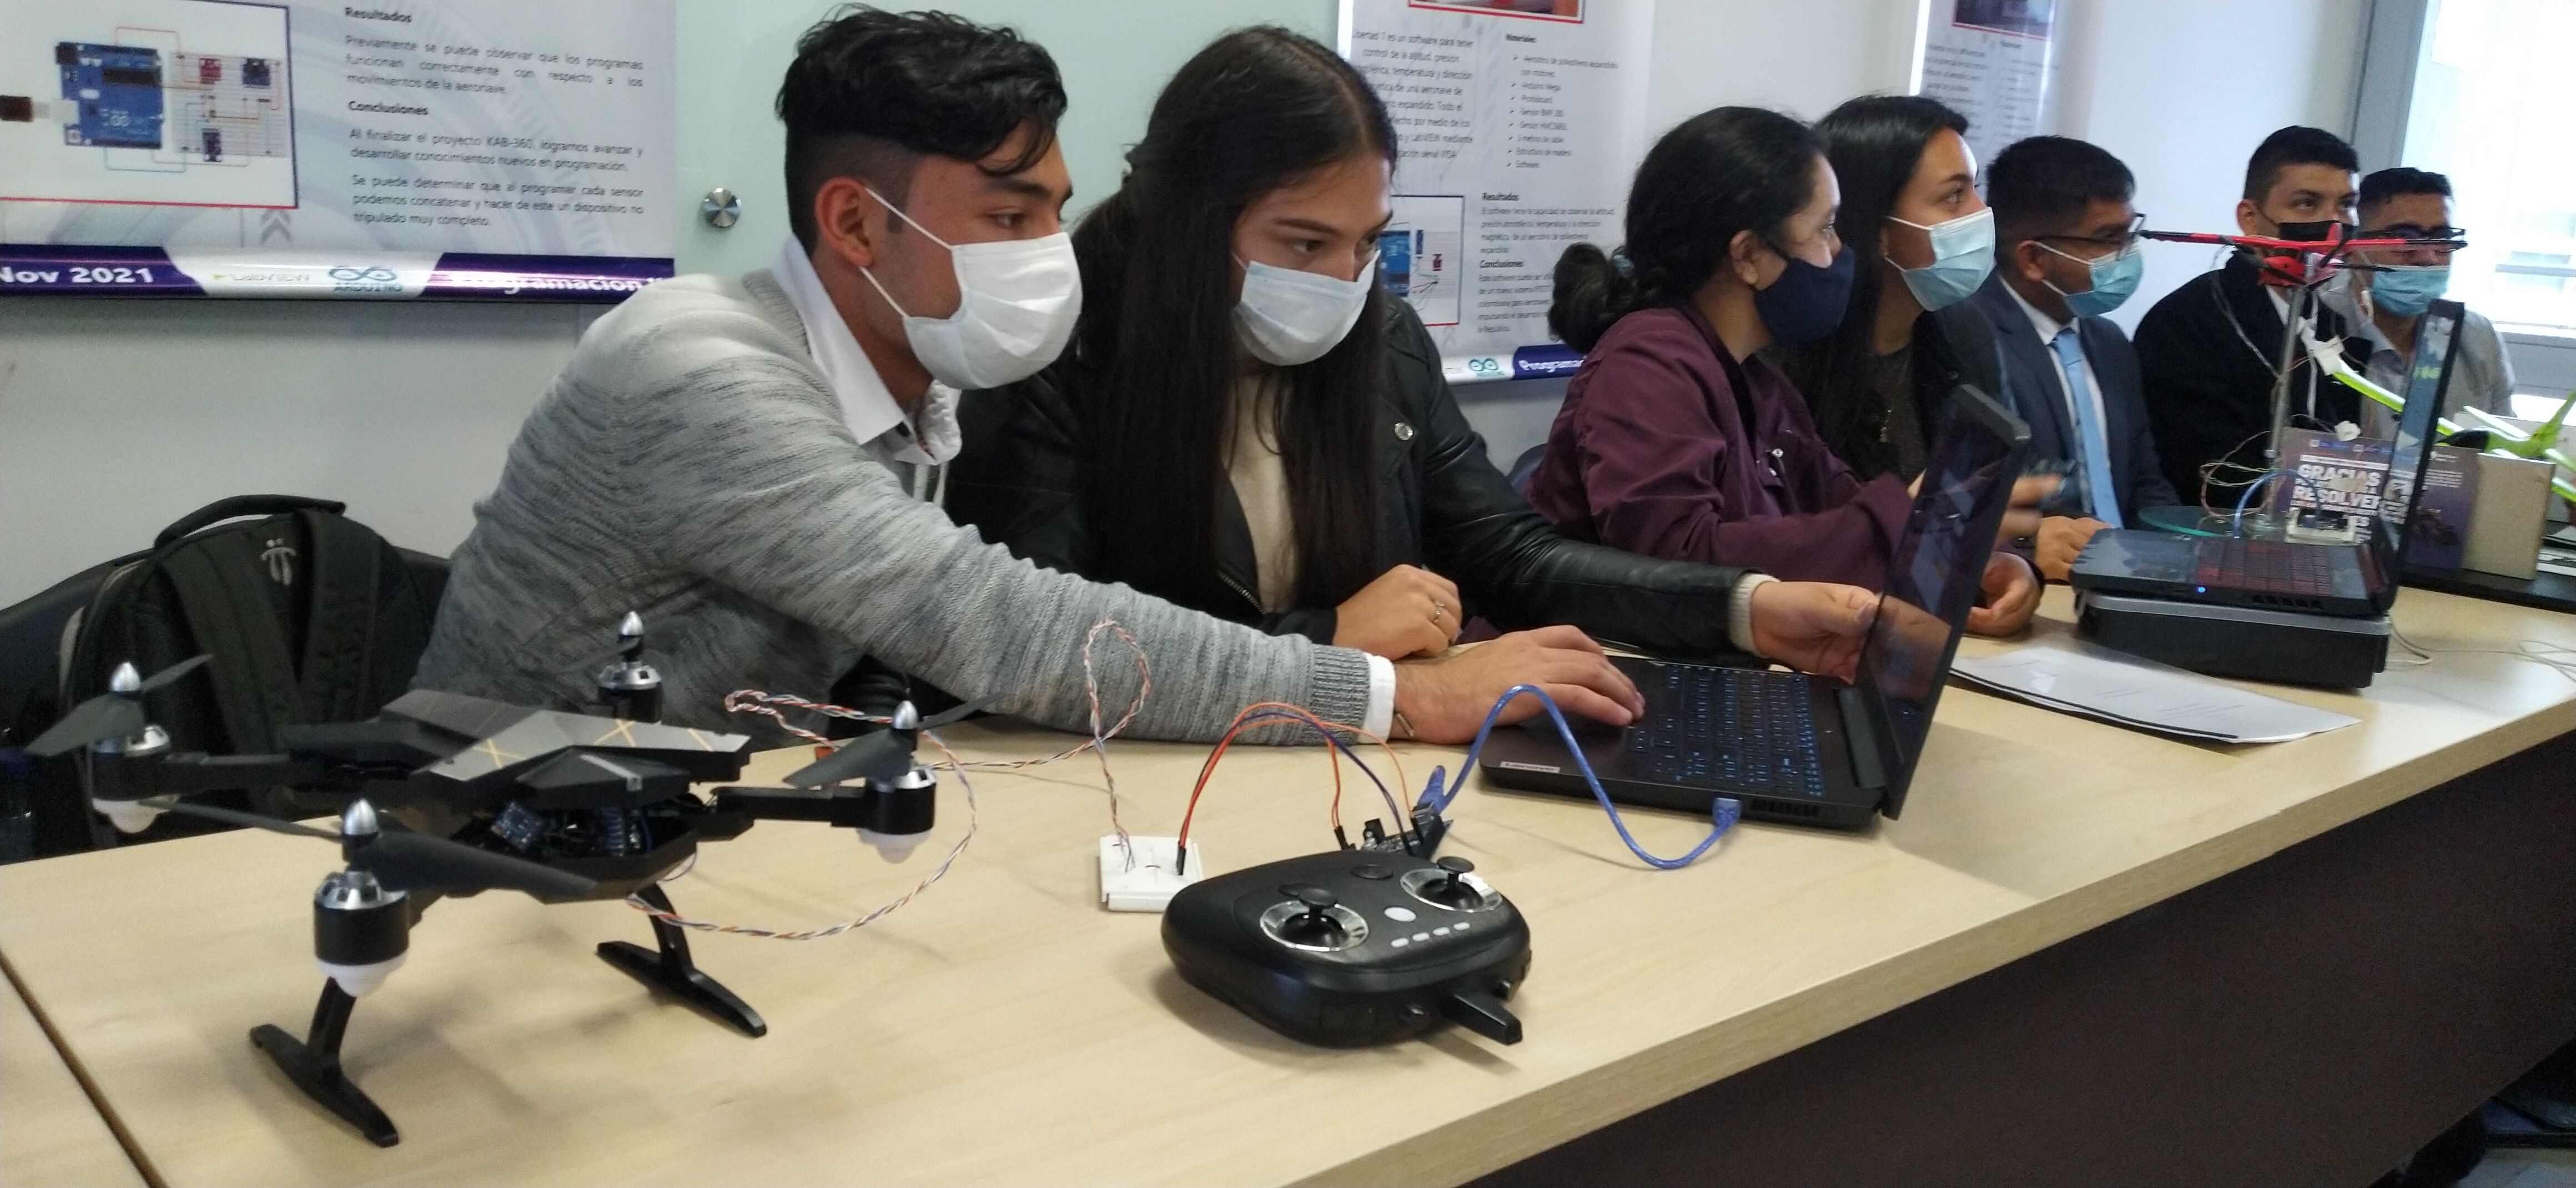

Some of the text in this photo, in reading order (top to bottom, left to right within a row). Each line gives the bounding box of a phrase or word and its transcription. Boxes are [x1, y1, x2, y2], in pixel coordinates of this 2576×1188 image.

[344, 7, 412, 23] Resultados
[345, 35, 643, 70] Previamente se puede observar que los programas
[346, 53, 643, 87] funcionan correctamente con respecto a los
[347, 73, 422, 88] movimientos
[425, 78, 440, 89] de
[442, 79, 454, 90] la
[348, 100, 430, 116] Conclusiones
[350, 128, 363, 139] Al
[366, 128, 413, 142] finalizar
[417, 132, 428, 143] el
[432, 135, 482, 148] proyecto
[540, 140, 589, 154] logramos
[592, 145, 632, 154] avanzar
[637, 147, 644, 158] y
[350, 147, 412, 160] desarrollar
[415, 151, 496, 165] conocimientos
[497, 157, 537, 167] nuevos
[538, 158, 552, 167] en
[351, 174, 644, 198] Se puede determinar que al programar cada sensor
[351, 194, 645, 214] podemos concatenar y hacer de este un dispositivo no
[353, 212, 407, 225] tripulado
[409, 215, 435, 227] muy
[1479, 259, 1525, 269] Conclusiones
[68, 267, 154, 284] 2021
[2297, 464, 2382, 487] GRACIAS
